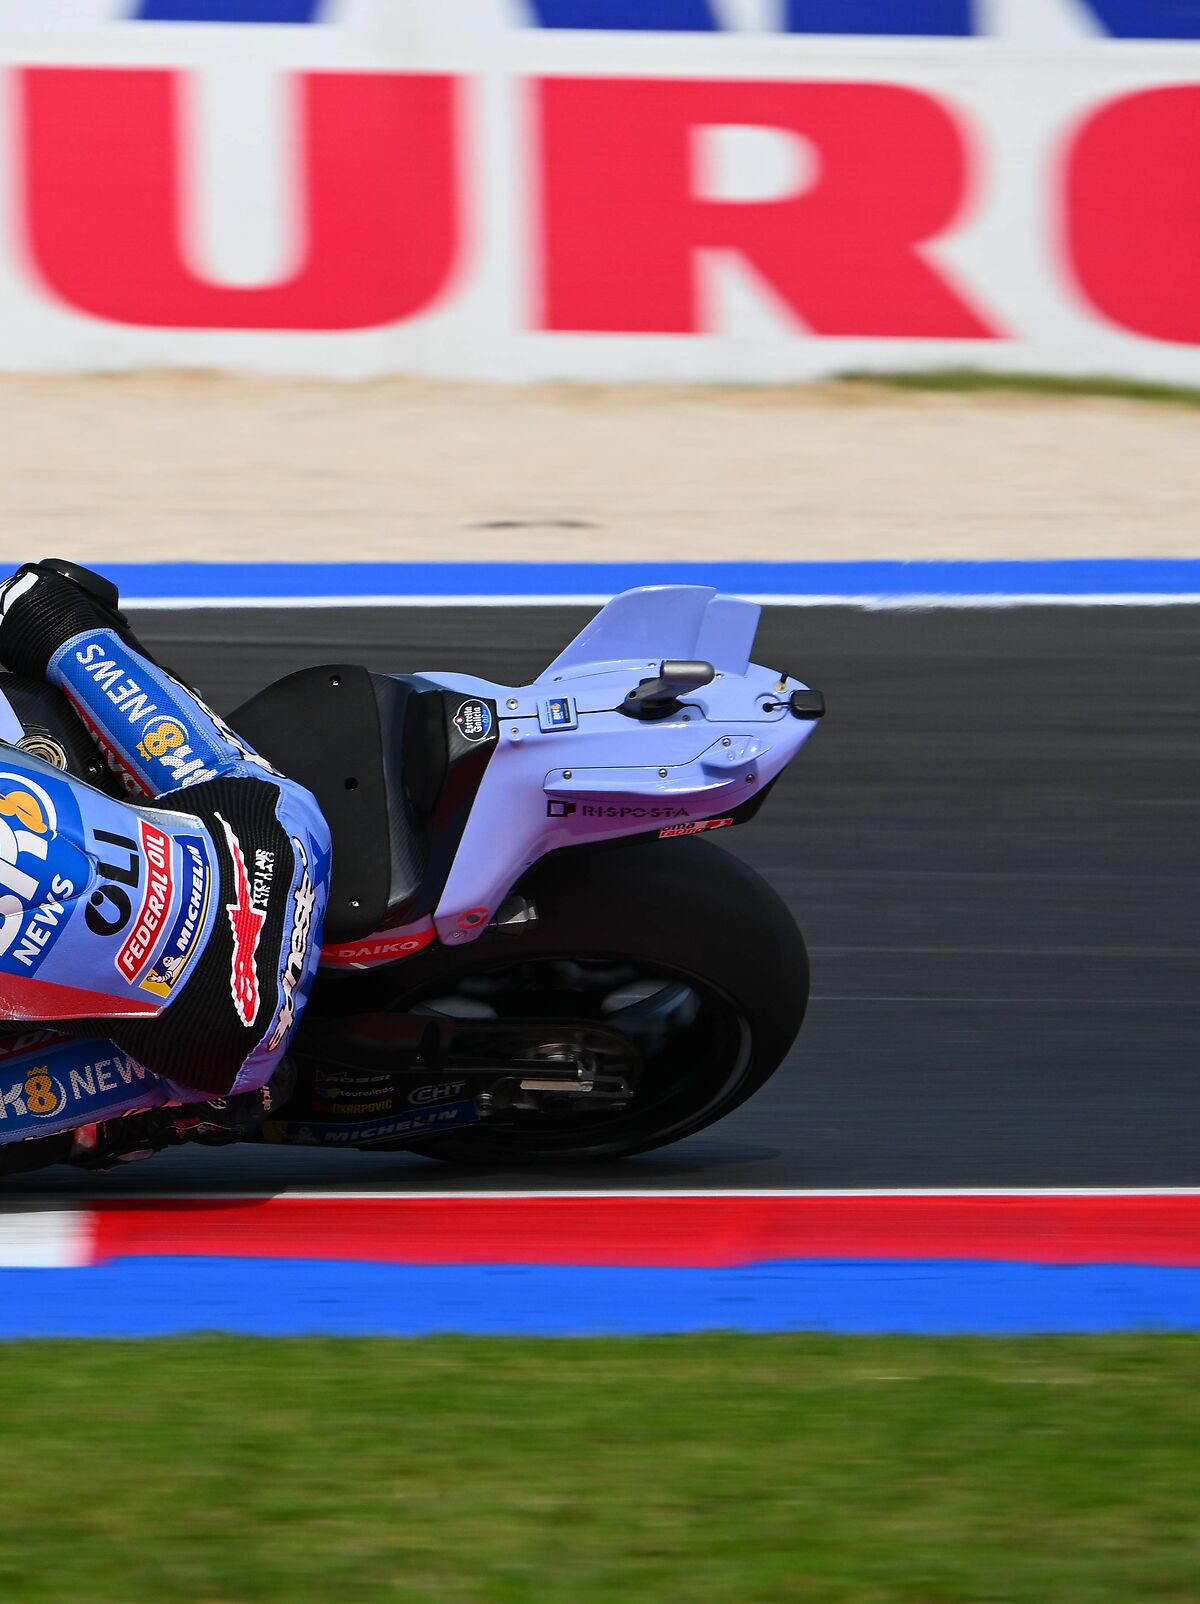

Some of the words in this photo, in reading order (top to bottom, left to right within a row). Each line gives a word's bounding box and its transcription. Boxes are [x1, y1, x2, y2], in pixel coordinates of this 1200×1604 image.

[76, 644, 158, 723] NEWS
[13, 873, 74, 967] NEWS
[122, 873, 167, 973] FEDERAL
[150, 834, 166, 872] OIL
[176, 844, 204, 952] MICHELIN
[337, 940, 420, 959] DAIKO
[324, 1109, 459, 1142] MICHELIN
